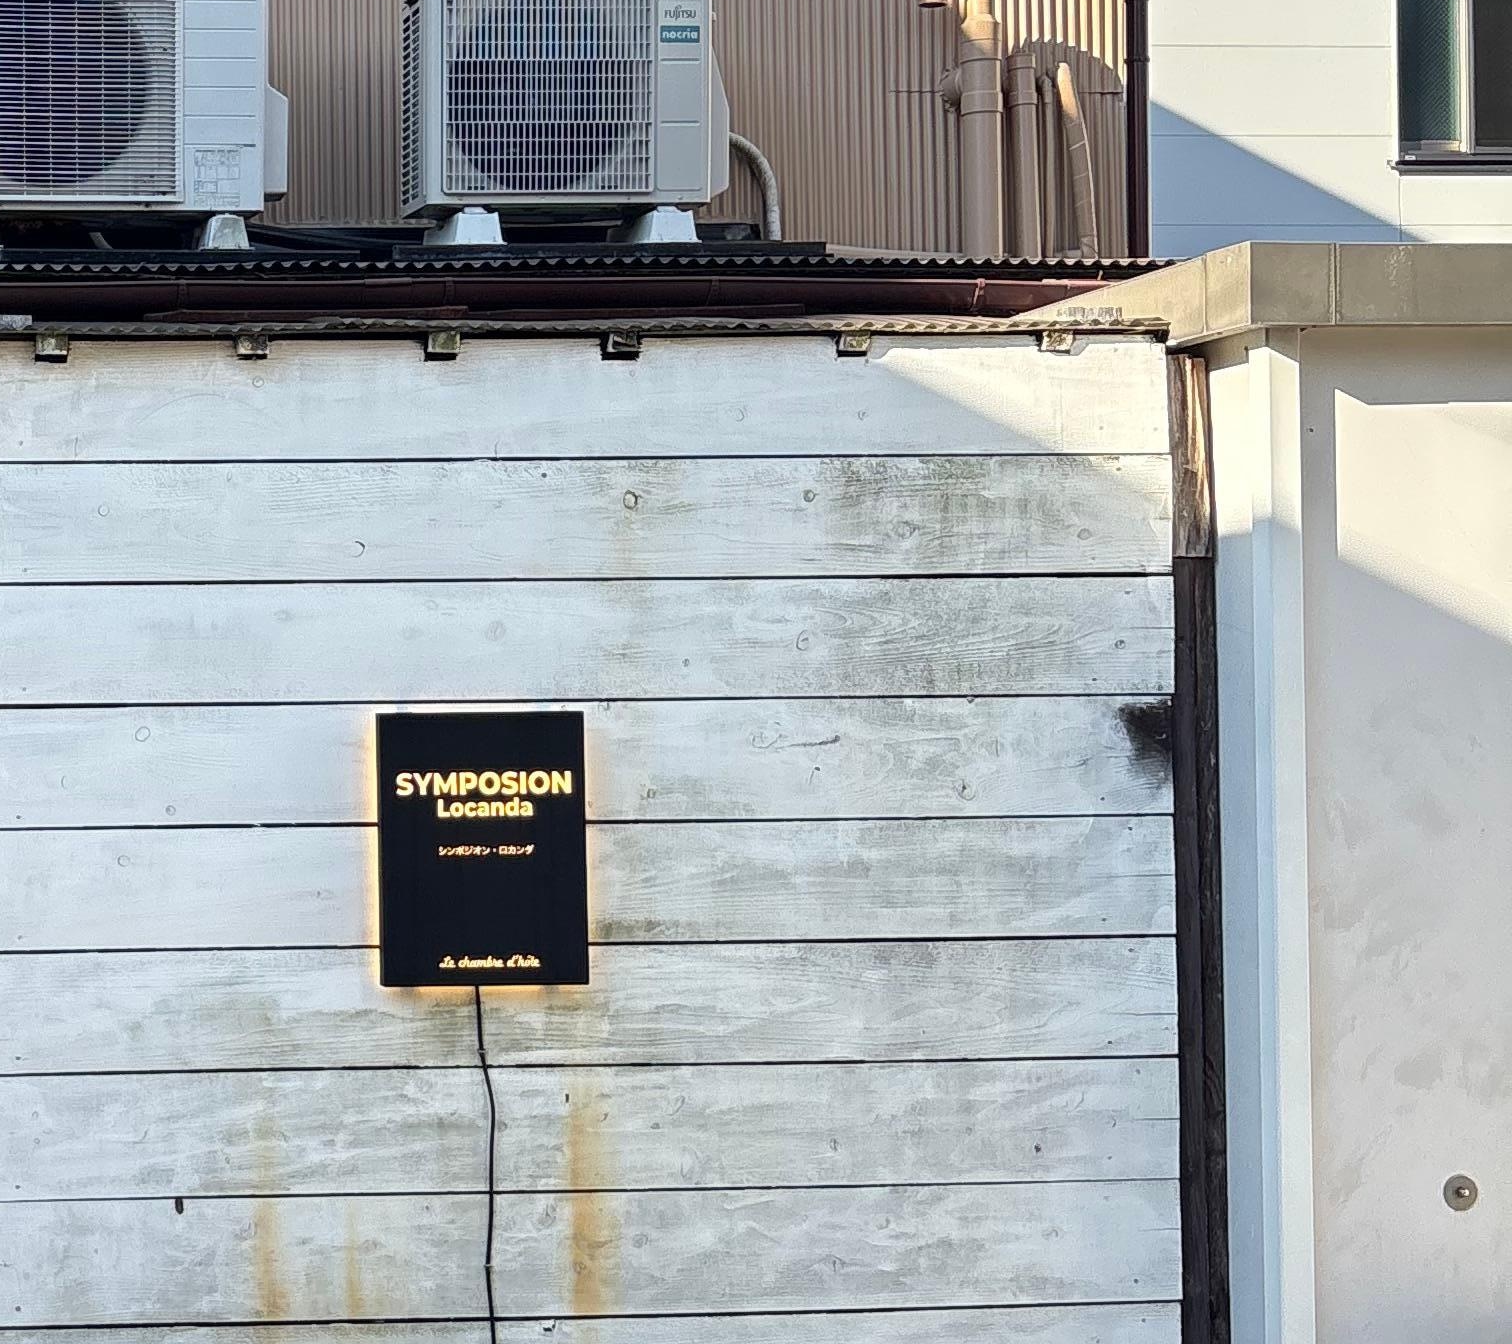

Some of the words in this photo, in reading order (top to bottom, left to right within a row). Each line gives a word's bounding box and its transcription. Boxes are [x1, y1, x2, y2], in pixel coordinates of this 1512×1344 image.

[664, 4, 696, 21] FUJITSU
[662, 28, 698, 40] nocria
[395, 771, 572, 796] SYMPOSION
[437, 798, 534, 818] Locanda
[457, 955, 505, 968] chambre
